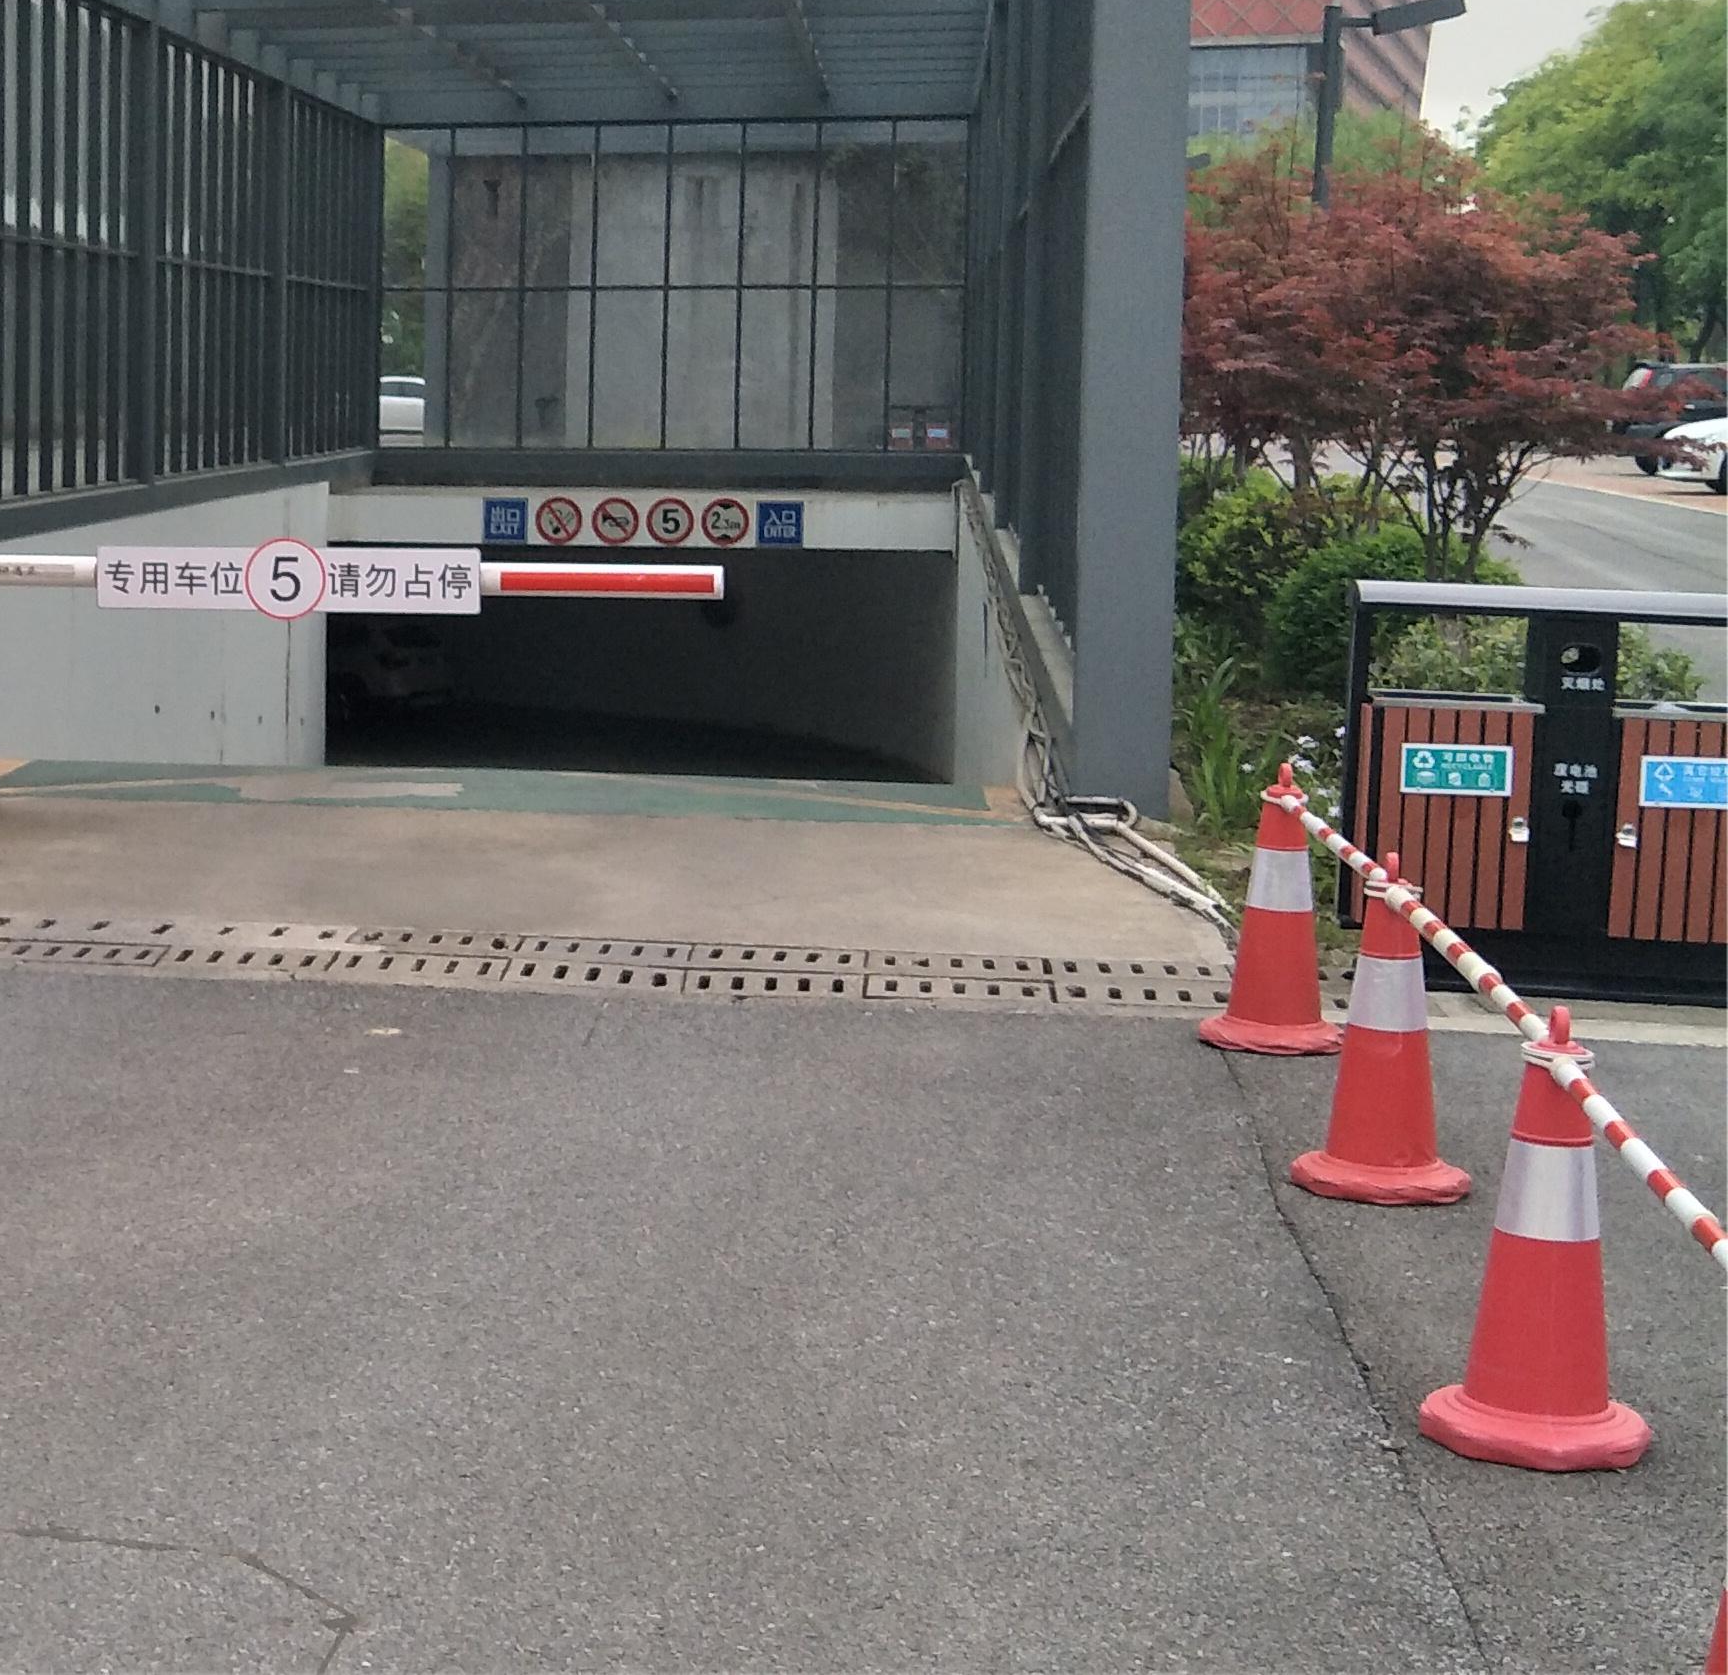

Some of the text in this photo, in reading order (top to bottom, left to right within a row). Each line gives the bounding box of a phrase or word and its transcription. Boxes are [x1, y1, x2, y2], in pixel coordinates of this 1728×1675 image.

[490, 507, 519, 524] 出口
[662, 508, 681, 535] 5
[765, 509, 796, 524] 入口
[490, 524, 520, 536] EXIT
[104, 556, 472, 603] 专用车位 5 请勿占停
